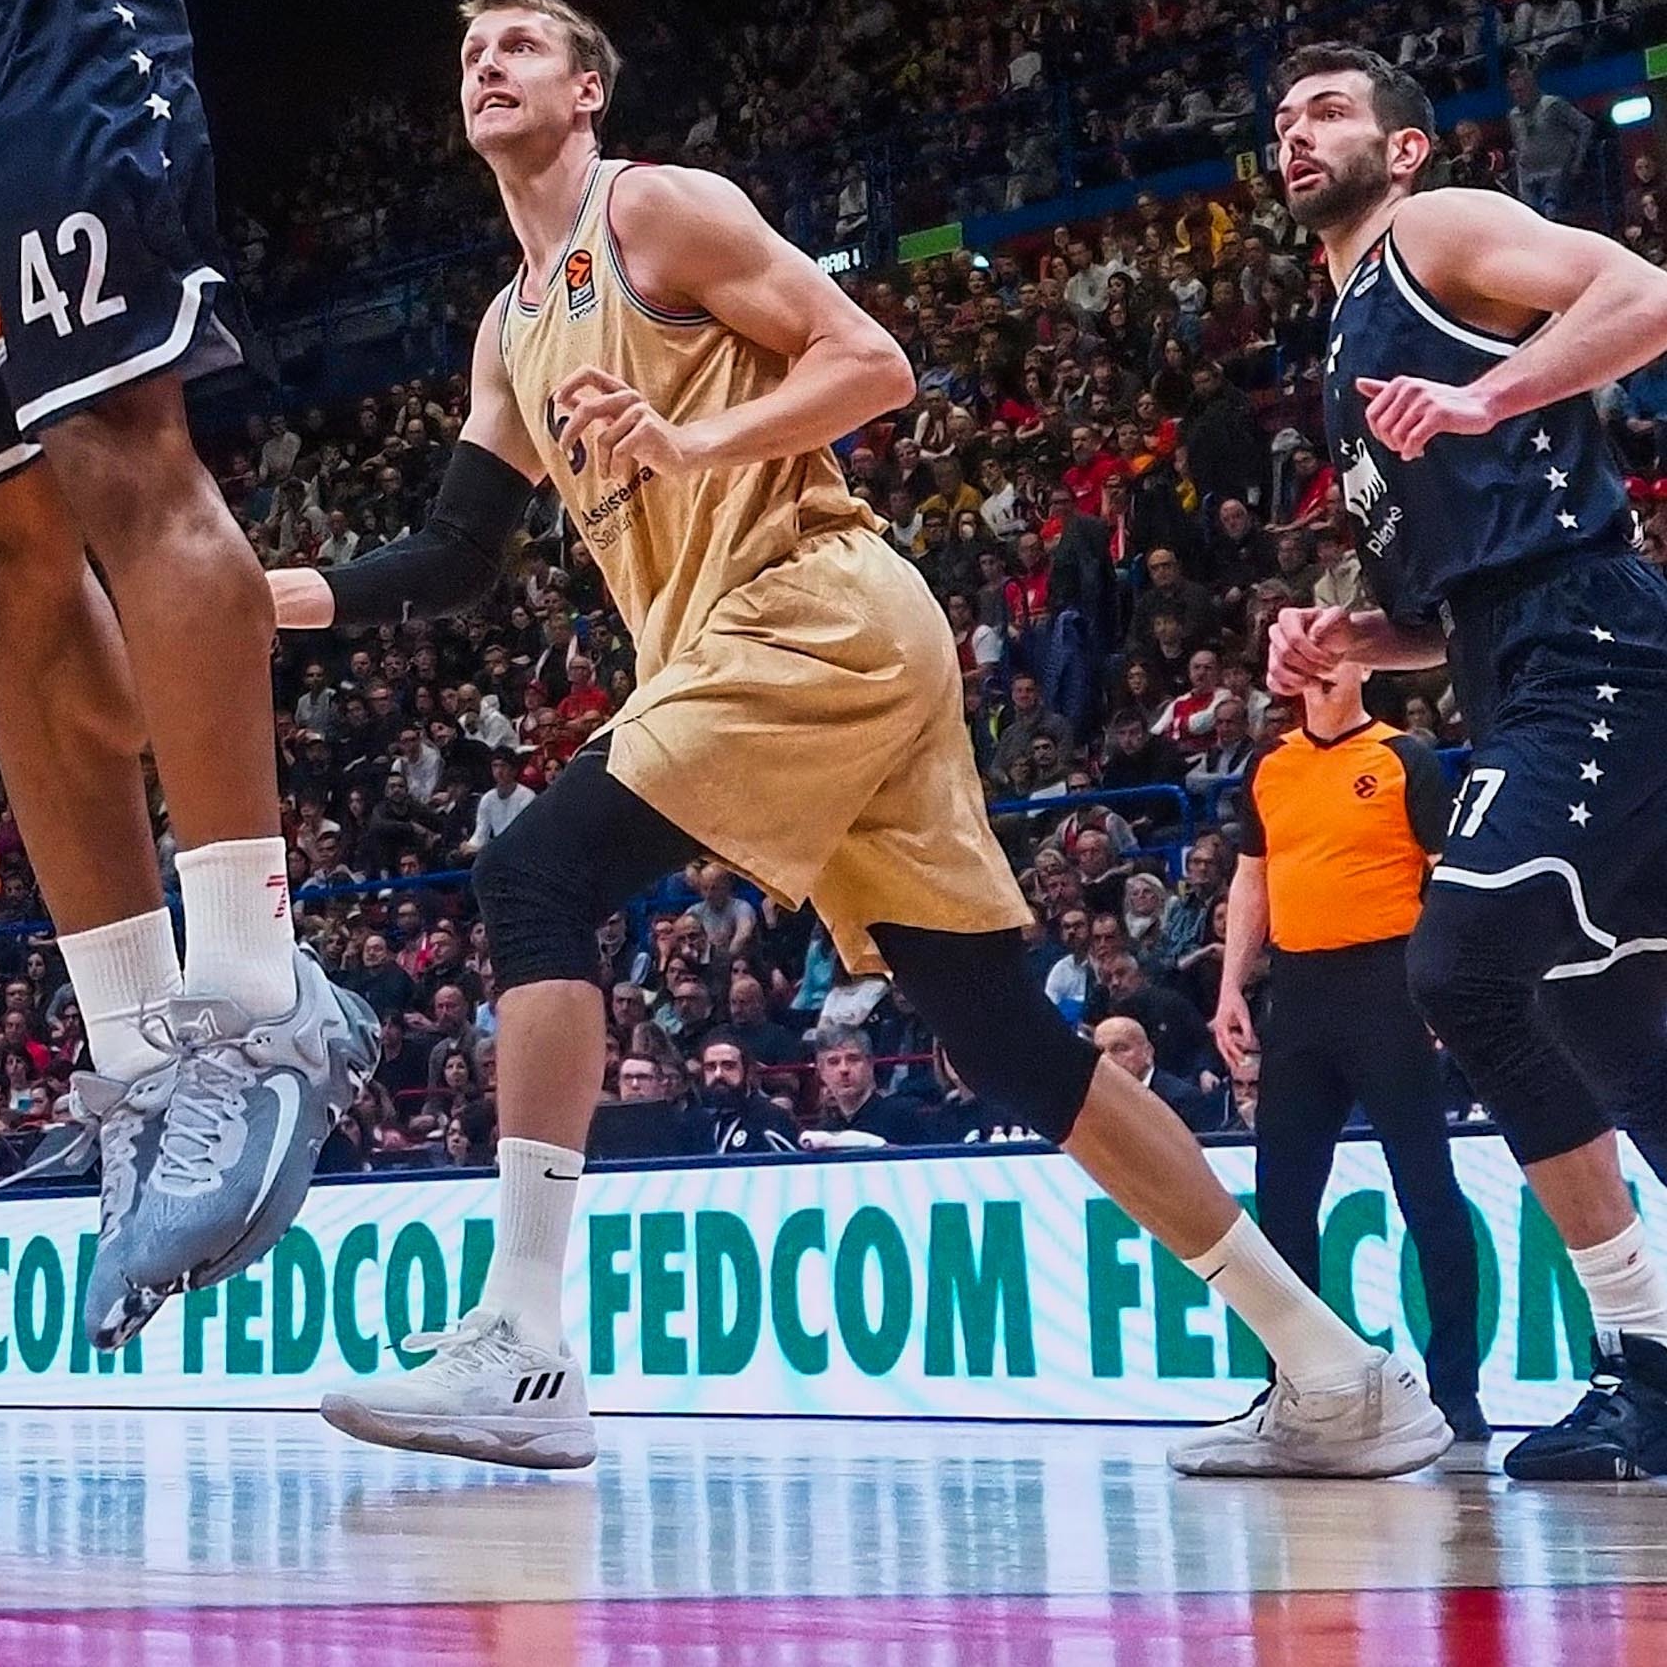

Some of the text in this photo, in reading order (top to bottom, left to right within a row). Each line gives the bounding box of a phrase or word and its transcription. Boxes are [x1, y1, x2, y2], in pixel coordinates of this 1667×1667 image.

[20, 210, 128, 338] 42
[817, 250, 851, 275] BAR
[180, 1217, 497, 1375] FEDCO
[587, 1199, 1039, 1378] FEDCOM
[1085, 1180, 1641, 1381] FECO
